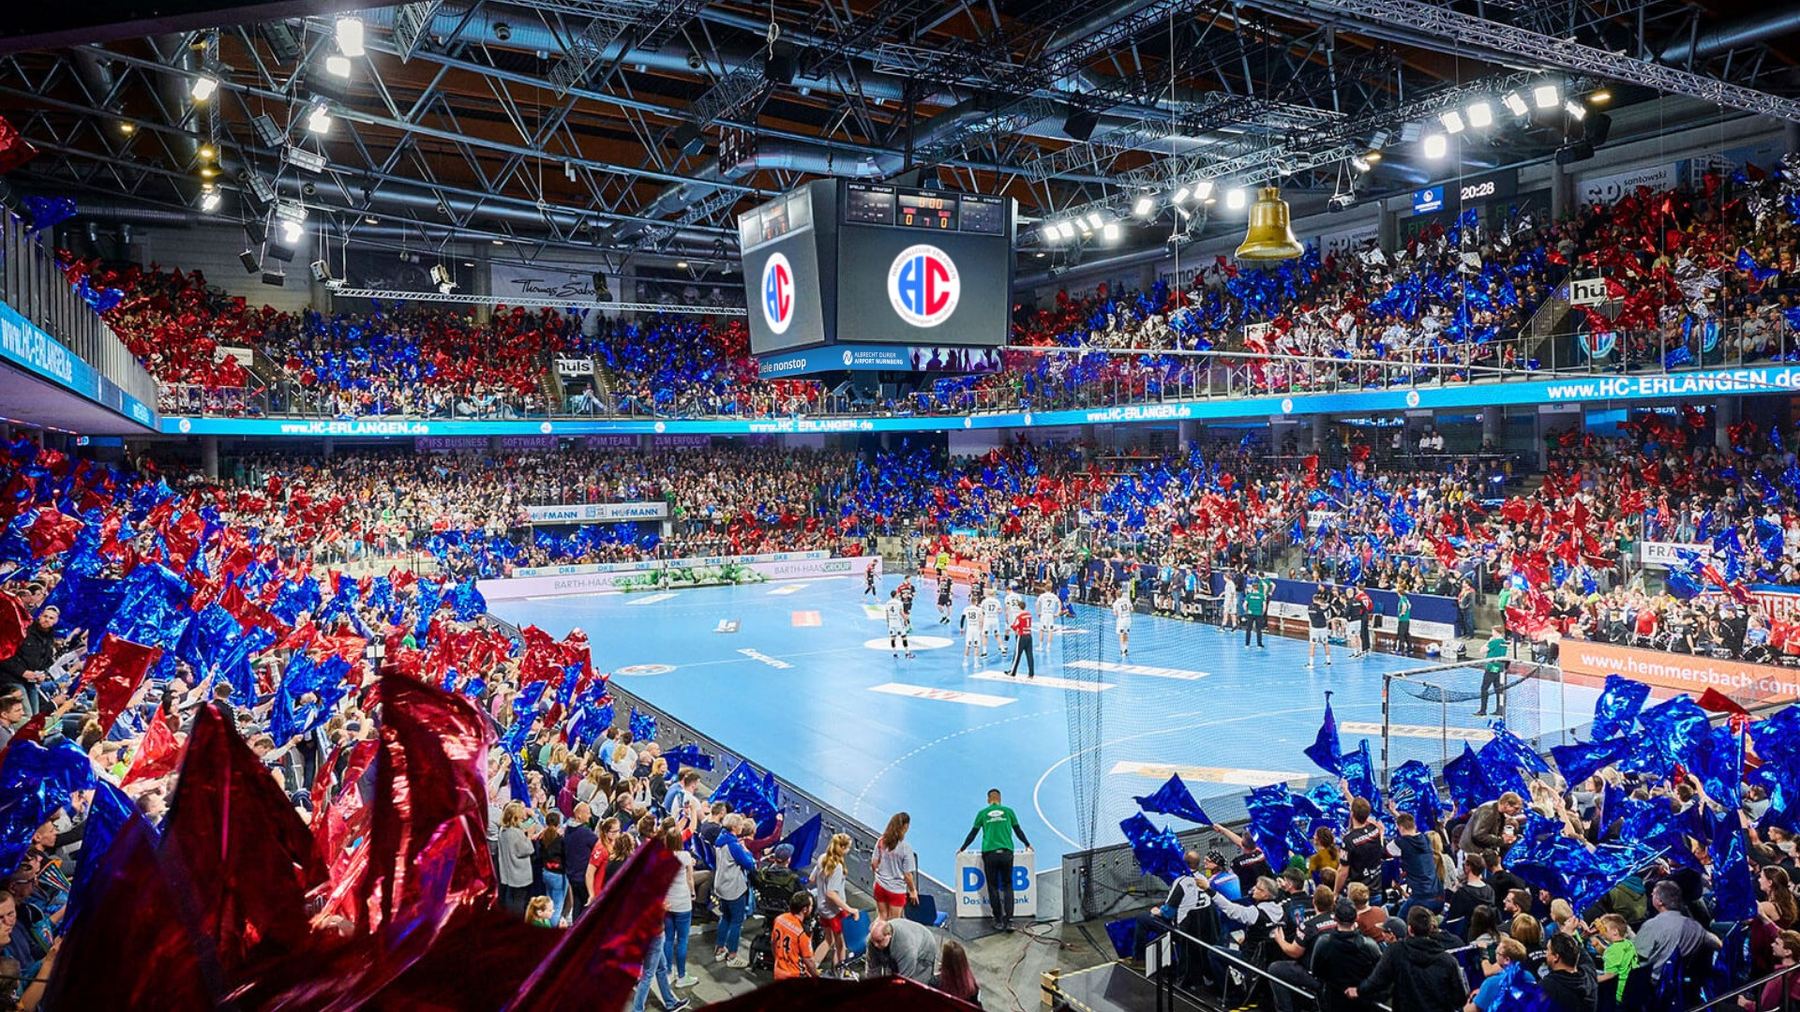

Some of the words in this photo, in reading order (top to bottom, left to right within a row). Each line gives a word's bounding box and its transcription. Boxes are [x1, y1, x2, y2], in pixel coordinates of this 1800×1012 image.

[1461, 181, 1494, 200] 20:28
[511, 279, 559, 297] Thomas
[556, 282, 597, 297] Sabo
[766, 264, 790, 323] HC
[898, 255, 950, 316] HC
[773, 358, 807, 371] nonstop
[1546, 368, 1800, 399] www.HC-ERLANGEN.de
[445, 438, 488, 447] BUSINESS
[502, 437, 546, 447] SOFTWARE
[610, 437, 630, 446] TEAM
[1581, 654, 1800, 696] www.hemmersbach.com
[962, 866, 1030, 892] DB
[963, 896, 981, 905] Das
